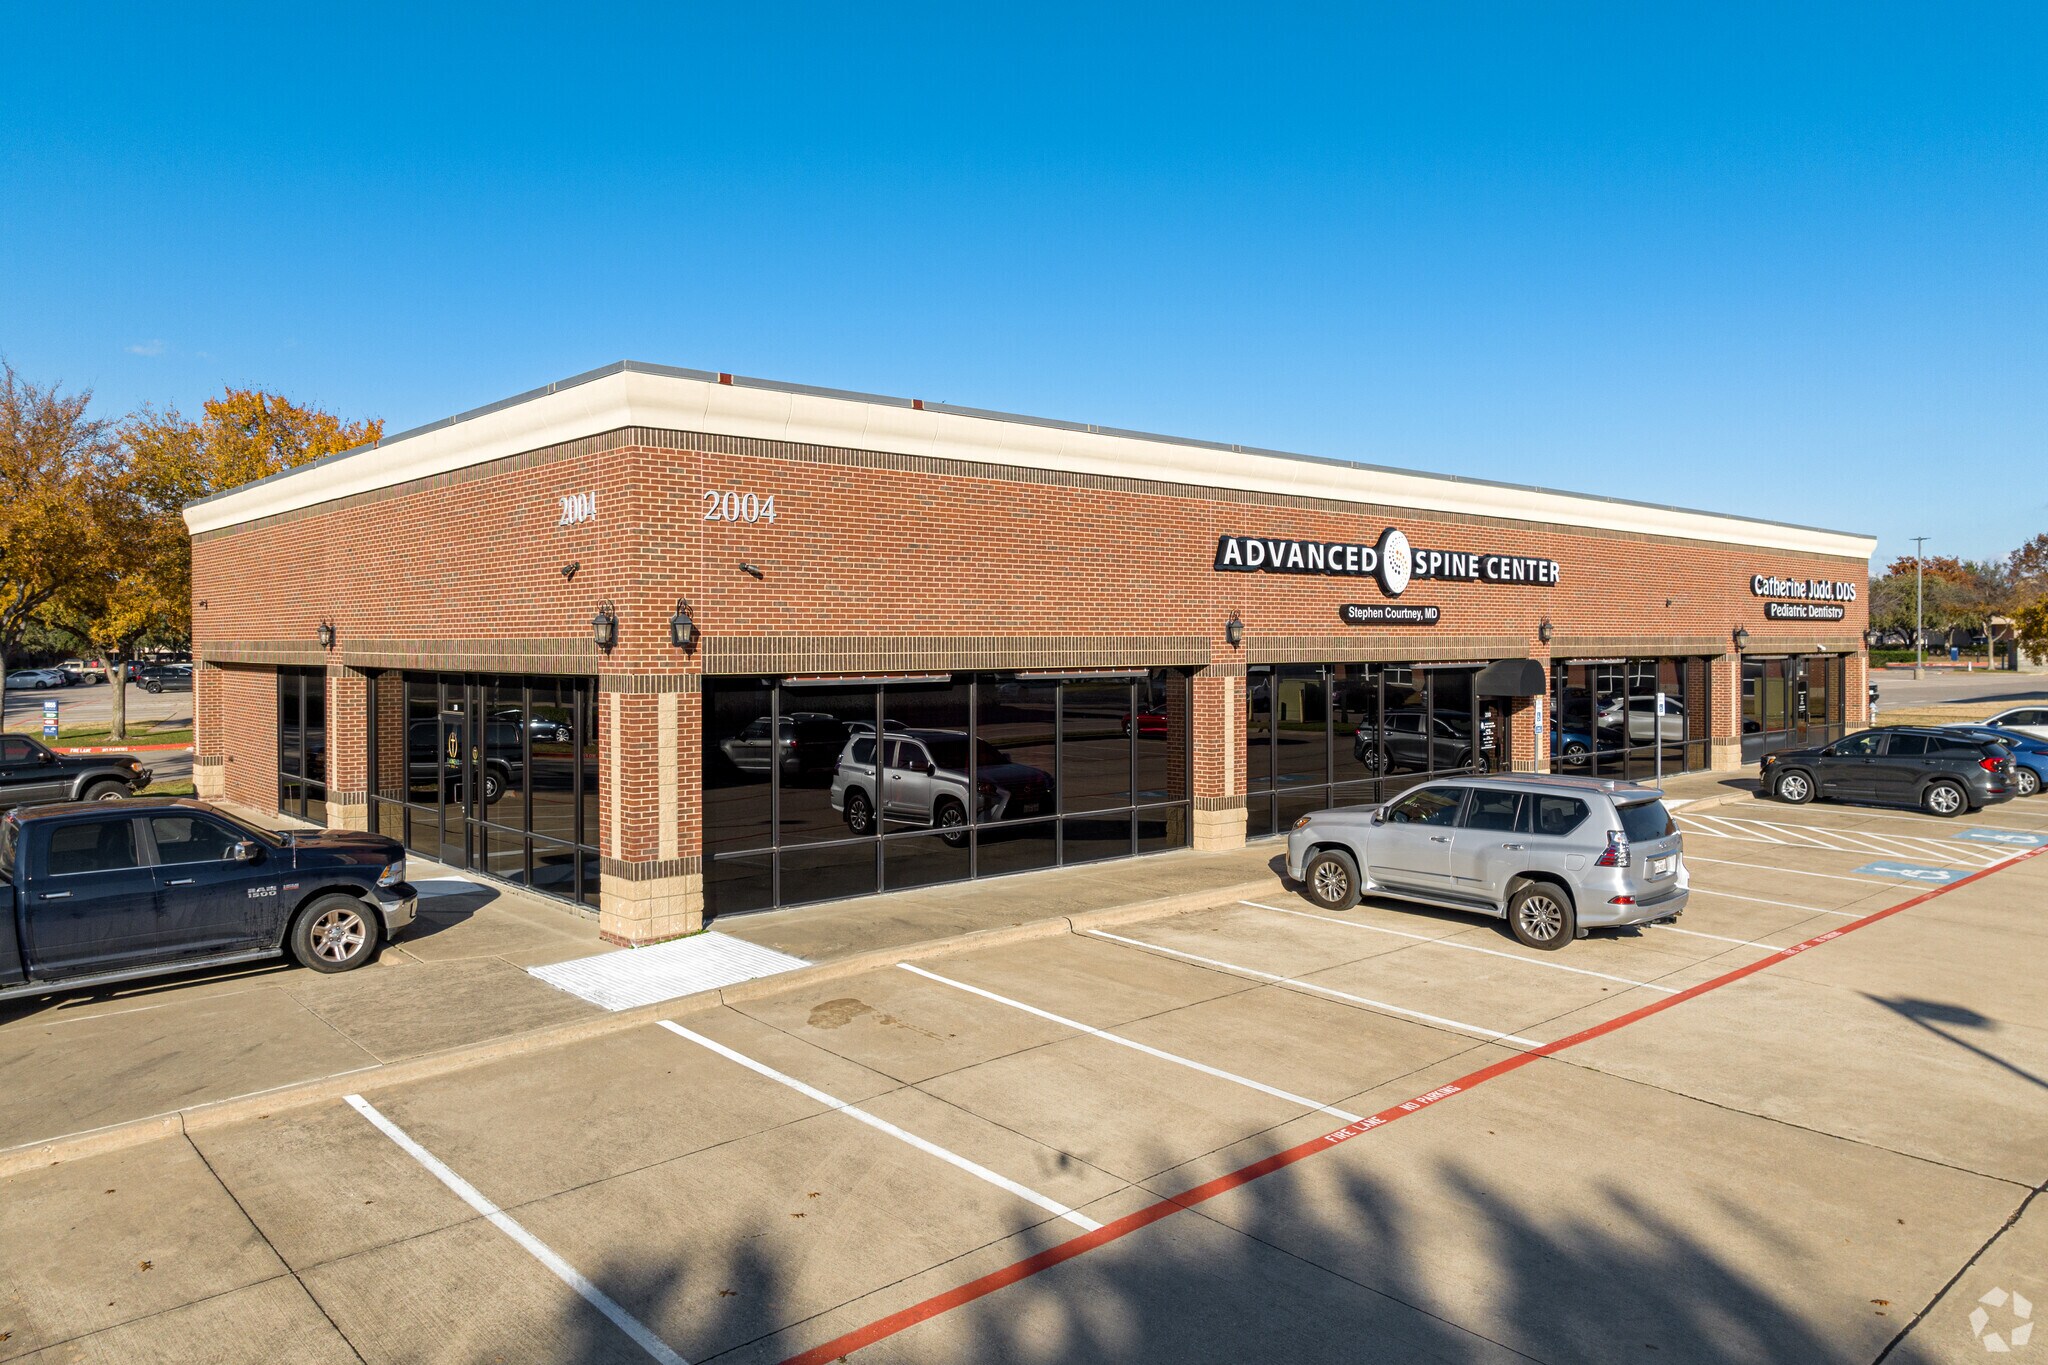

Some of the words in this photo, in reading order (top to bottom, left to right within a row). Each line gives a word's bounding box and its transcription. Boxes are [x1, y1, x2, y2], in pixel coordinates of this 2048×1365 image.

[559, 491, 597, 526] 2004
[703, 490, 777, 524] 2004
[1223, 538, 1379, 573] ADVANCED
[1415, 551, 1480, 578] SPINE
[1486, 557, 1561, 583] CENTER
[1754, 574, 1806, 598] Catherine
[1808, 579, 1834, 600] Judd,
[1836, 582, 1856, 601] DDS
[1348, 606, 1384, 621] Stephen
[1385, 607, 1424, 622] Courtney,
[1425, 608, 1438, 620] MD
[1771, 603, 1807, 618] Pediatric
[1808, 605, 1843, 619] Dentistry
[248, 890, 277, 898] 1500
[1324, 1128, 1357, 1143] FIRE
[1352, 1116, 1387, 1131] LANE
[1399, 1099, 1420, 1112] NO
[1416, 1085, 1461, 1104] PARKING
